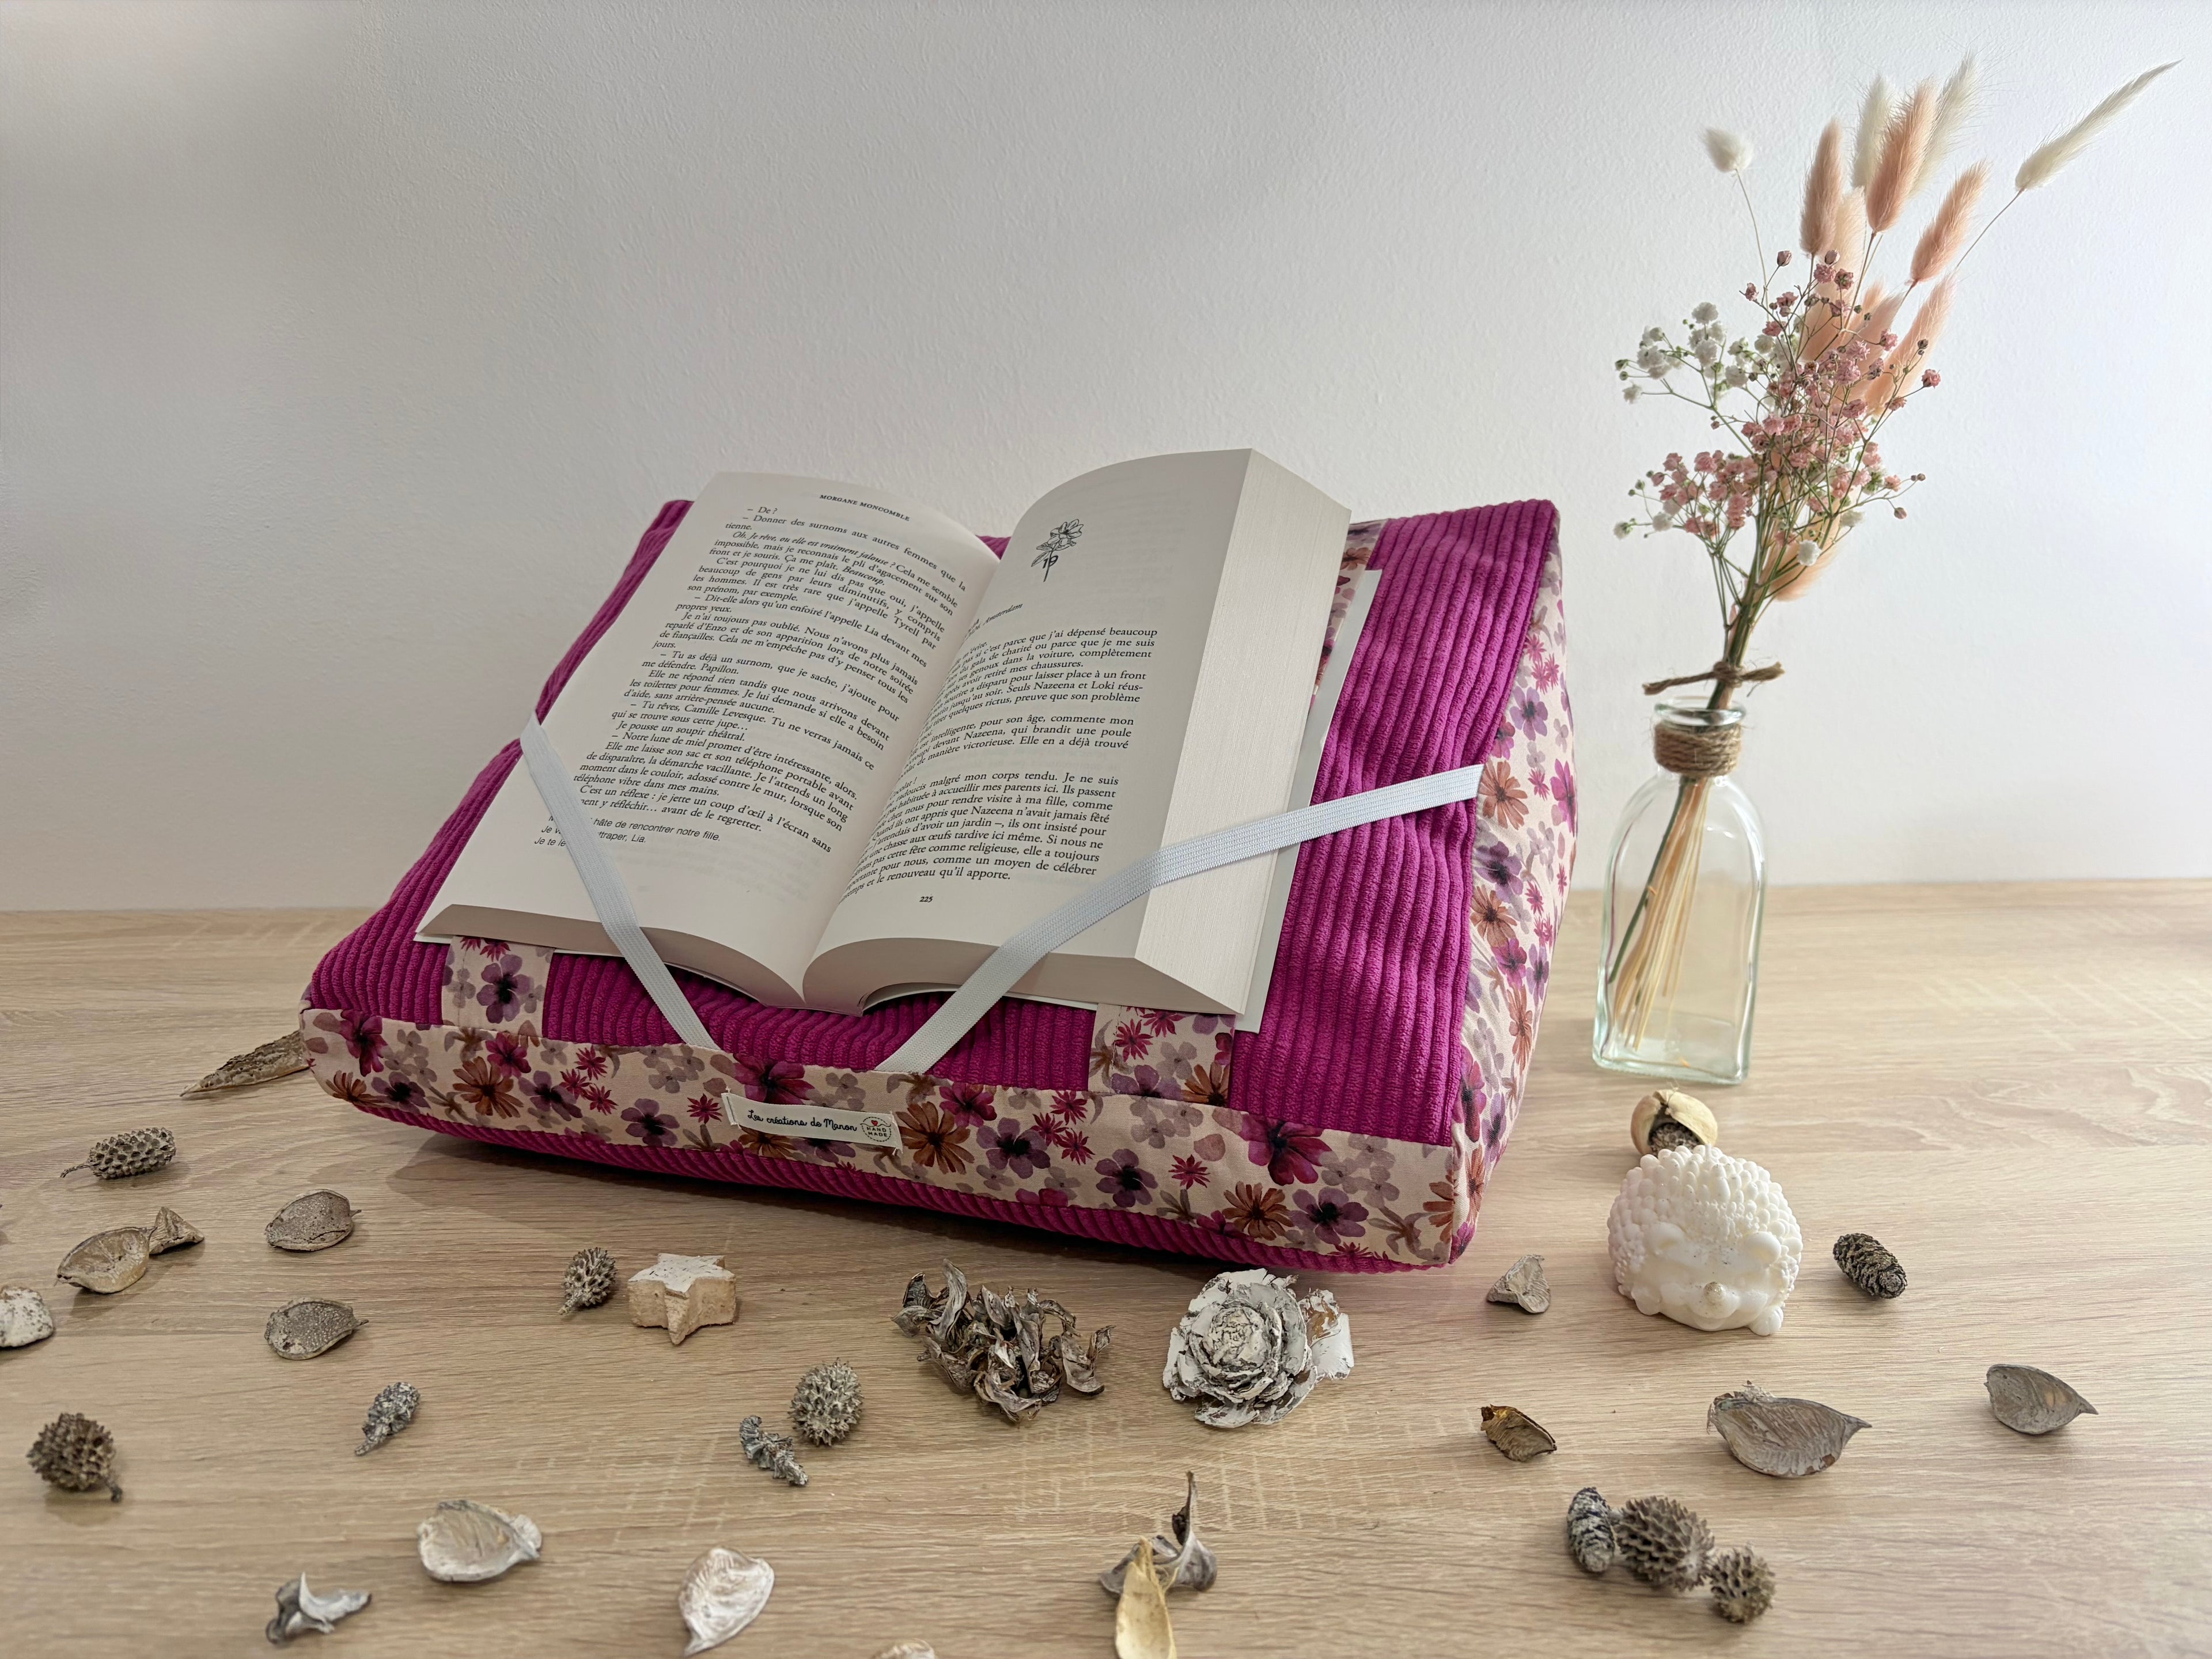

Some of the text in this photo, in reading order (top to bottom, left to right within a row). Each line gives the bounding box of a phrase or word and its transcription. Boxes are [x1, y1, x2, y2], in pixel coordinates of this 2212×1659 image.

[819, 494, 910, 521] MORGANE MONCOMBLE
[708, 547, 731, 556] front
[740, 550, 752, 559] je
[752, 552, 781, 560] souris.
[783, 554, 797, 563] Ça
[813, 559, 838, 570] plaît.
[841, 565, 885, 586] Beaucoup.
[1042, 555, 1059, 569] 19
[713, 539, 953, 616] impossible, mais je reconnais le pli d'agacement sur son
[715, 556, 739, 566] C'est
[739, 560, 783, 570] pourquoi
[783, 563, 795, 573] je
[813, 567, 828, 577] lui
[830, 572, 846, 582] dis
[846, 578, 865, 588] pas
[868, 585, 886, 596] que
[889, 594, 907, 608] oui,
[908, 604, 945, 633] j'appelle
[680, 611, 918, 685] Je n'ai toujours pas oublié. Nous n'avons plus jamais
[983, 626, 1158, 654] c'est parce que j'ai dépensé beaucoup
[961, 660, 1084, 688] avoir retiré mes chaussures.
[968, 661, 1000, 679] genoux
[1001, 656, 1024, 665] dans
[1025, 652, 1035, 661] la
[1038, 650, 1074, 659] voiture,
[1078, 647, 1153, 659] complètement
[628, 678, 642, 687] les
[642, 679, 678, 690] toilettes
[677, 684, 702, 692] pour
[702, 683, 740, 696] femmes.
[741, 688, 755, 699] Je
[755, 690, 771, 701] lui
[771, 694, 817, 714] demande
[817, 710, 828, 718] si
[828, 714, 847, 726] elle
[855, 725, 884, 751] besoin
[647, 669, 666, 678] Elle
[681, 672, 716, 683] répond
[716, 675, 736, 685] rien
[738, 679, 768, 690] tandis
[770, 685, 790, 694] que
[791, 690, 817, 702] nous
[819, 699, 858, 720] arrivons
[859, 717, 890, 741] devant
[948, 702, 984, 720] quelques
[984, 696, 1012, 707] rictus,
[1013, 694, 1048, 704] preuve
[1049, 693, 1069, 702] que
[1089, 691, 1141, 703] problème
[615, 719, 628, 730] Je
[626, 723, 660, 732] pousse
[675, 726, 706, 737] soupir
[707, 728, 745, 741] théâtral.
[929, 722, 976, 743] intelligente,
[978, 718, 1003, 730] pour
[1026, 713, 1046, 725] âge,
[1050, 715, 1106, 724] commente
[1108, 717, 1134, 726] mon
[931, 735, 961, 750] devant
[963, 728, 1006, 741] Nazeena,
[1010, 725, 1029, 736] qui
[1032, 723, 1072, 734] brandit
[1099, 727, 1132, 738] poule
[926, 745, 961, 761] manière
[963, 738, 1015, 750] victorieuse.
[1018, 734, 1040, 745] Elle
[1068, 736, 1090, 749] déjà
[1093, 739, 1129, 749] trouvé
[573, 772, 719, 796] téléphone vibre dans mes mains.
[604, 741, 623, 751] Elle
[639, 743, 665, 754] laisse
[665, 748, 684, 756] son
[684, 750, 701, 758] sac
[714, 753, 732, 762] son
[734, 756, 784, 775] téléphone
[783, 771, 827, 794] portable
[828, 791, 854, 811] avant
[928, 770, 1119, 788] malgré mon corps tendu. Je ne suis
[887, 793, 1113, 823] chez nous pour rendre visite à ma fille, comme
[870, 841, 1100, 868] pas cette fête comme religieuse, elle a toujours
[748, 1109, 857, 1131] Les créations de Manon
